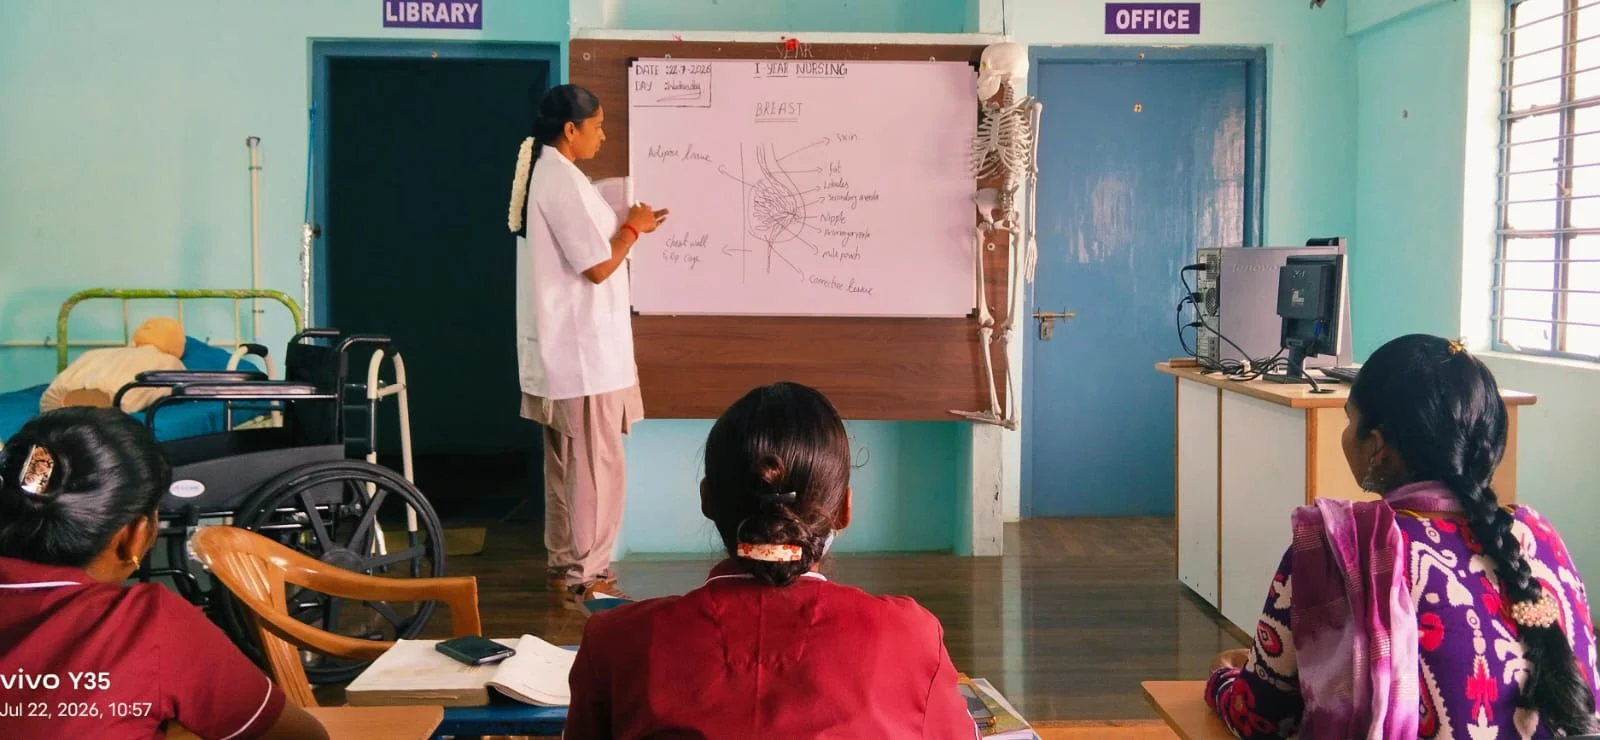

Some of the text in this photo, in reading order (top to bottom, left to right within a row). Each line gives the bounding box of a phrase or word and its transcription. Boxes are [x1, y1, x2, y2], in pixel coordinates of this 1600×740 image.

[386, 1, 479, 23] LIBRARY
[1116, 9, 1190, 30] OFFICE
[635, 64, 659, 75] DATE
[766, 62, 789, 75] YEAR
[796, 62, 848, 76] NURSING
[634, 80, 652, 91] DAY
[755, 101, 803, 118] BREAST
